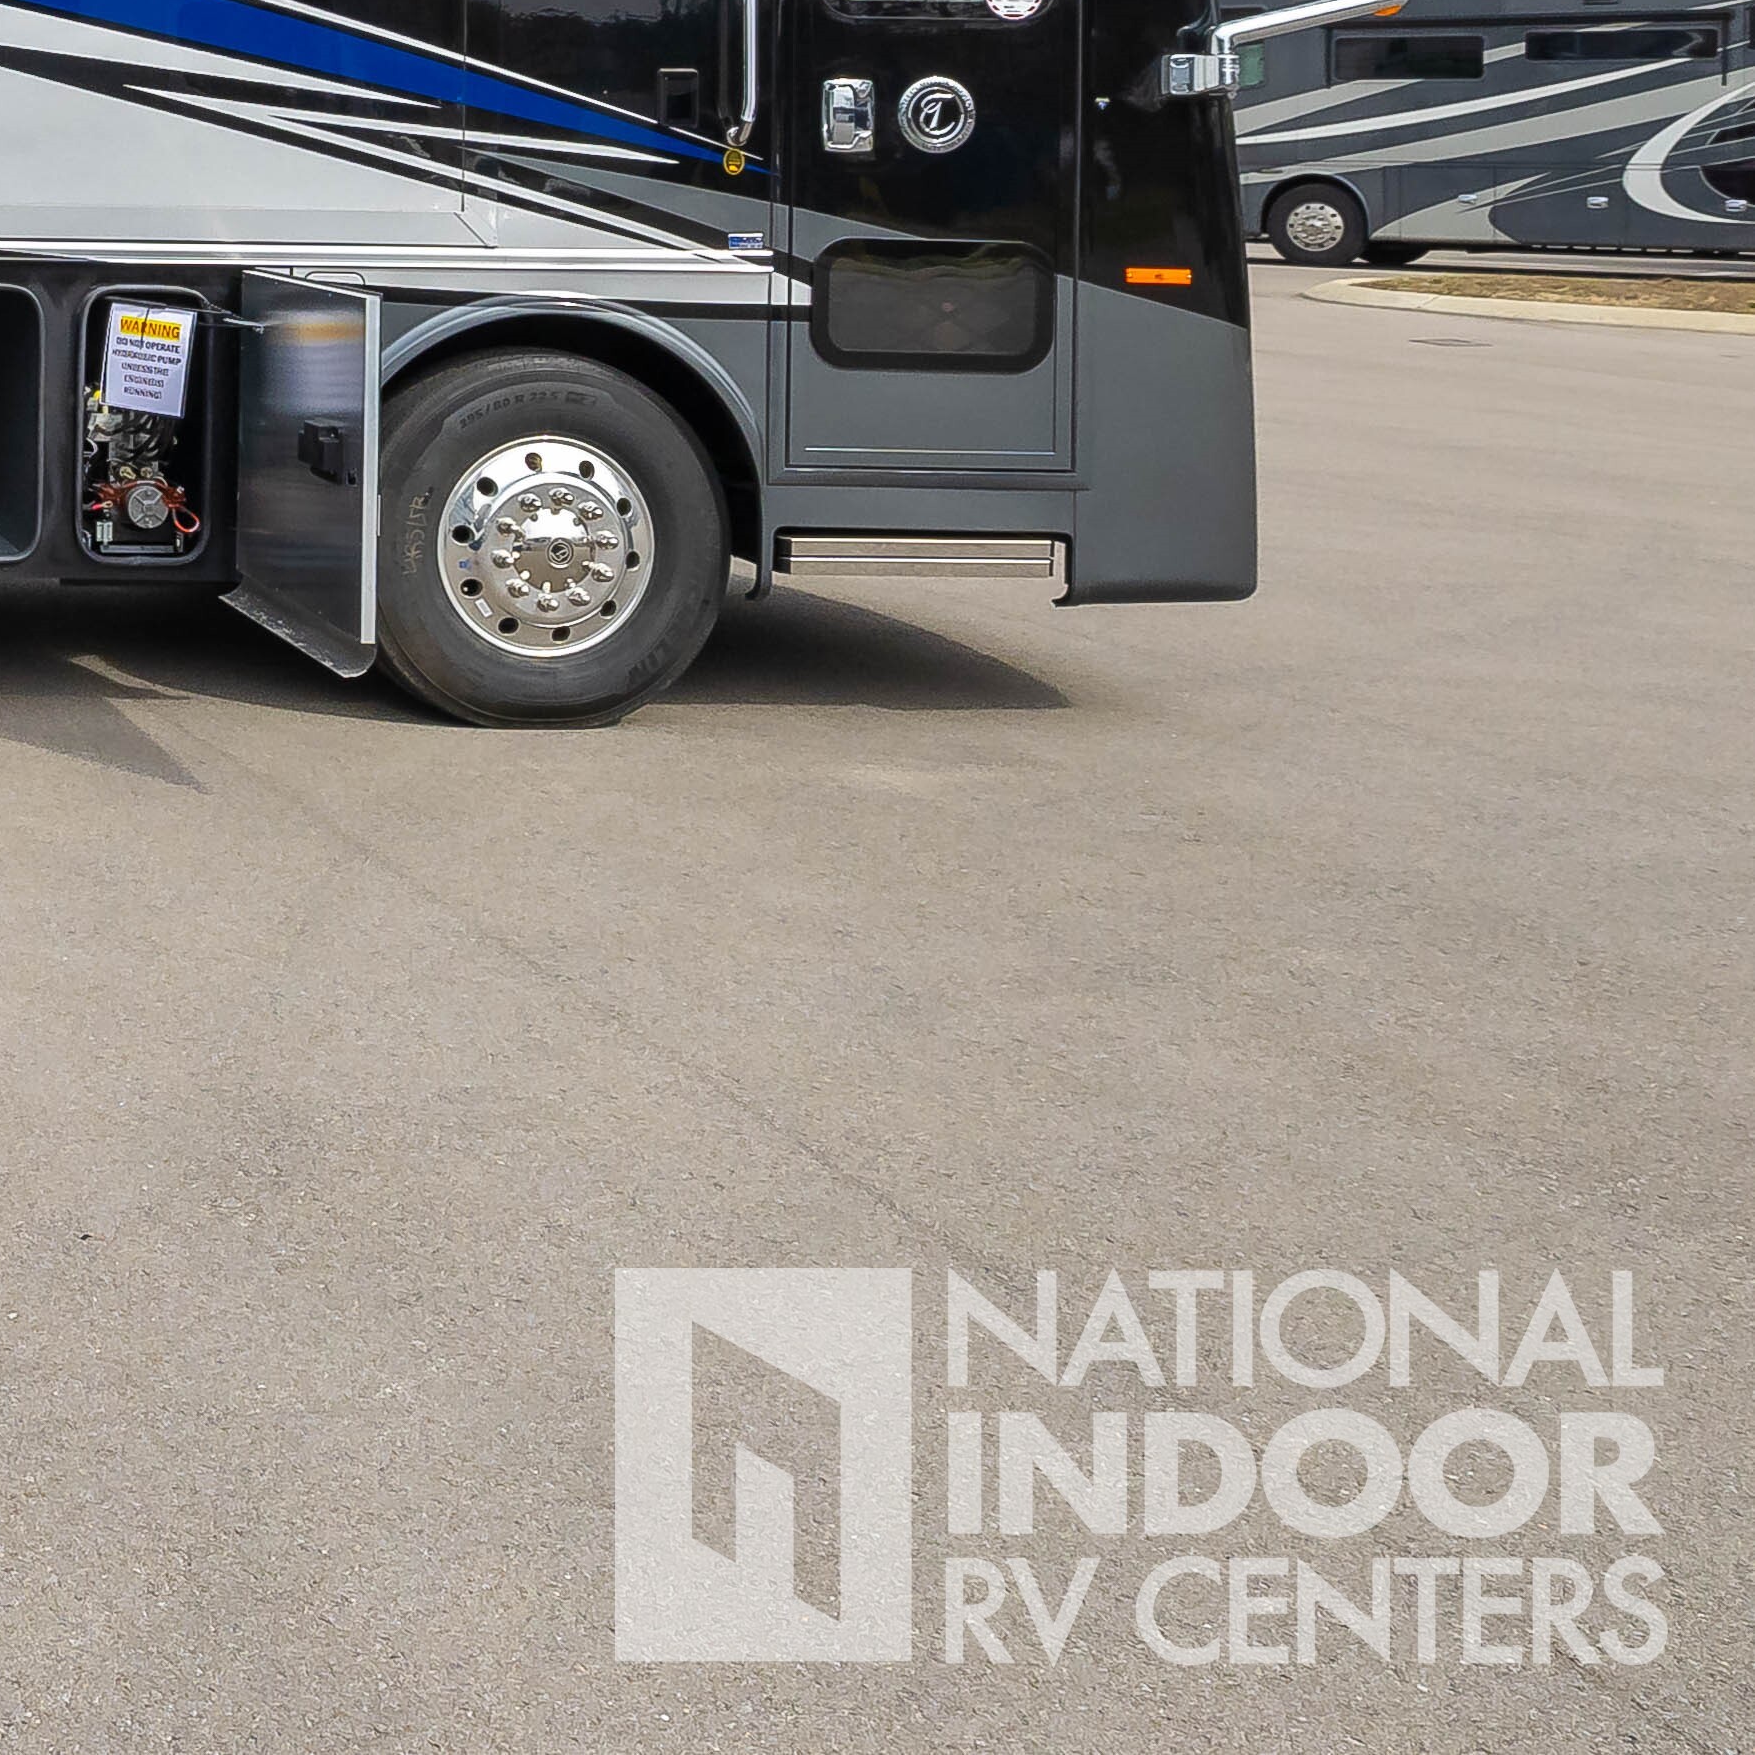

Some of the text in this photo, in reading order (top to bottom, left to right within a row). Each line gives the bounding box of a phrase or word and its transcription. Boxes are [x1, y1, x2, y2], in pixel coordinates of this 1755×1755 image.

[120, 318, 181, 339] WARNING
[145, 341, 181, 354] OPERATE
[157, 355, 182, 365] PUMP
